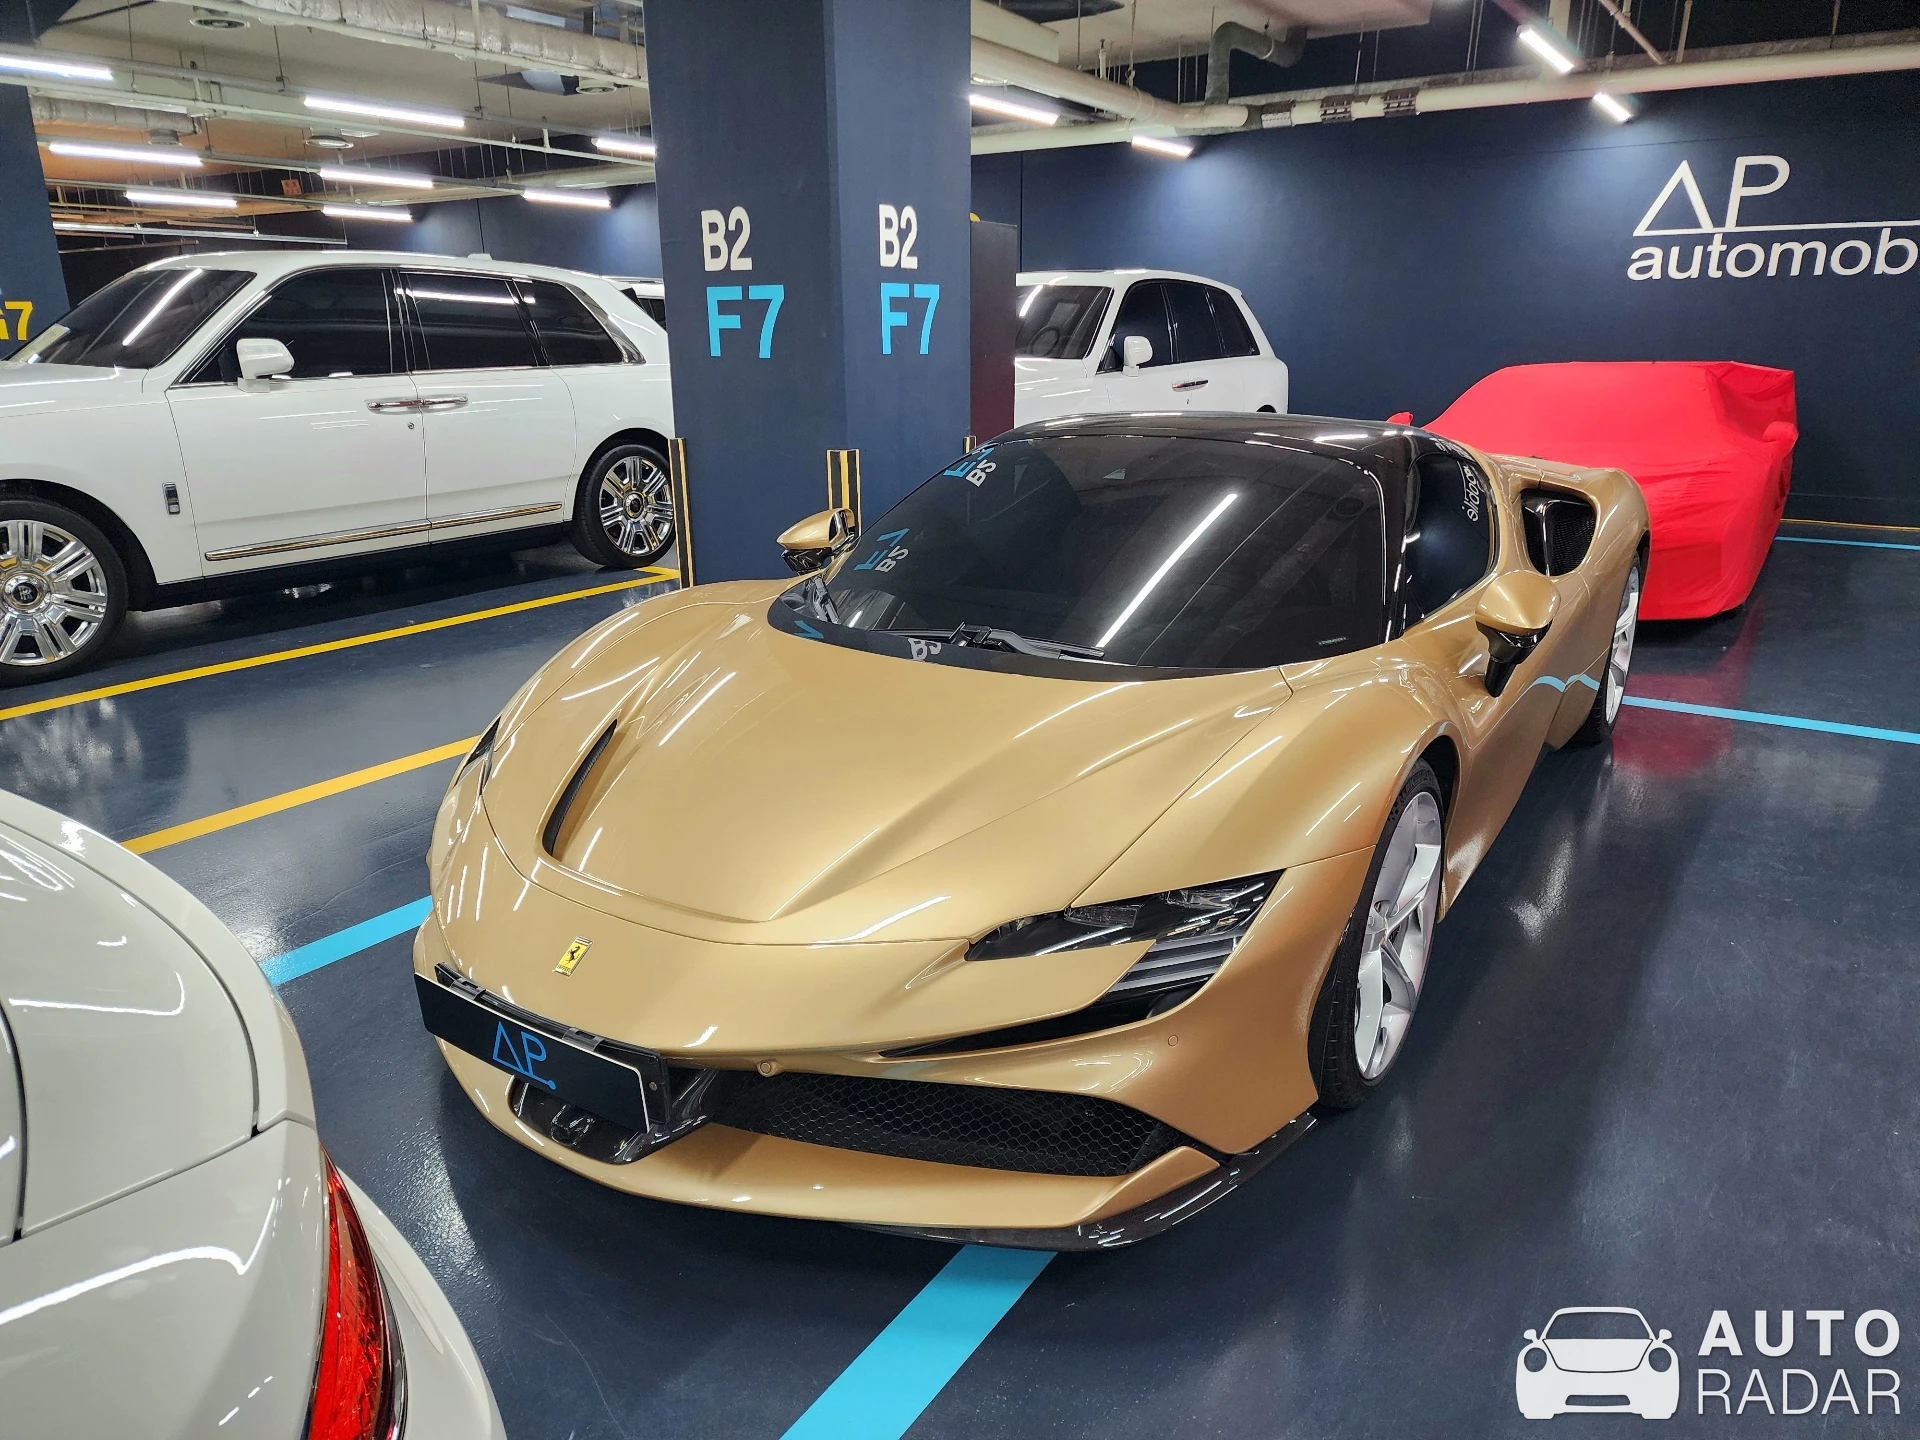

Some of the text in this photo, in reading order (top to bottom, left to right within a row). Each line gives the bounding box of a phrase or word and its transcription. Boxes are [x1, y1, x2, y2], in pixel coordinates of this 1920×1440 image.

[701, 206, 752, 272] B2
[878, 204, 918, 269] B2
[706, 284, 785, 359] F7
[880, 282, 940, 355] F7
